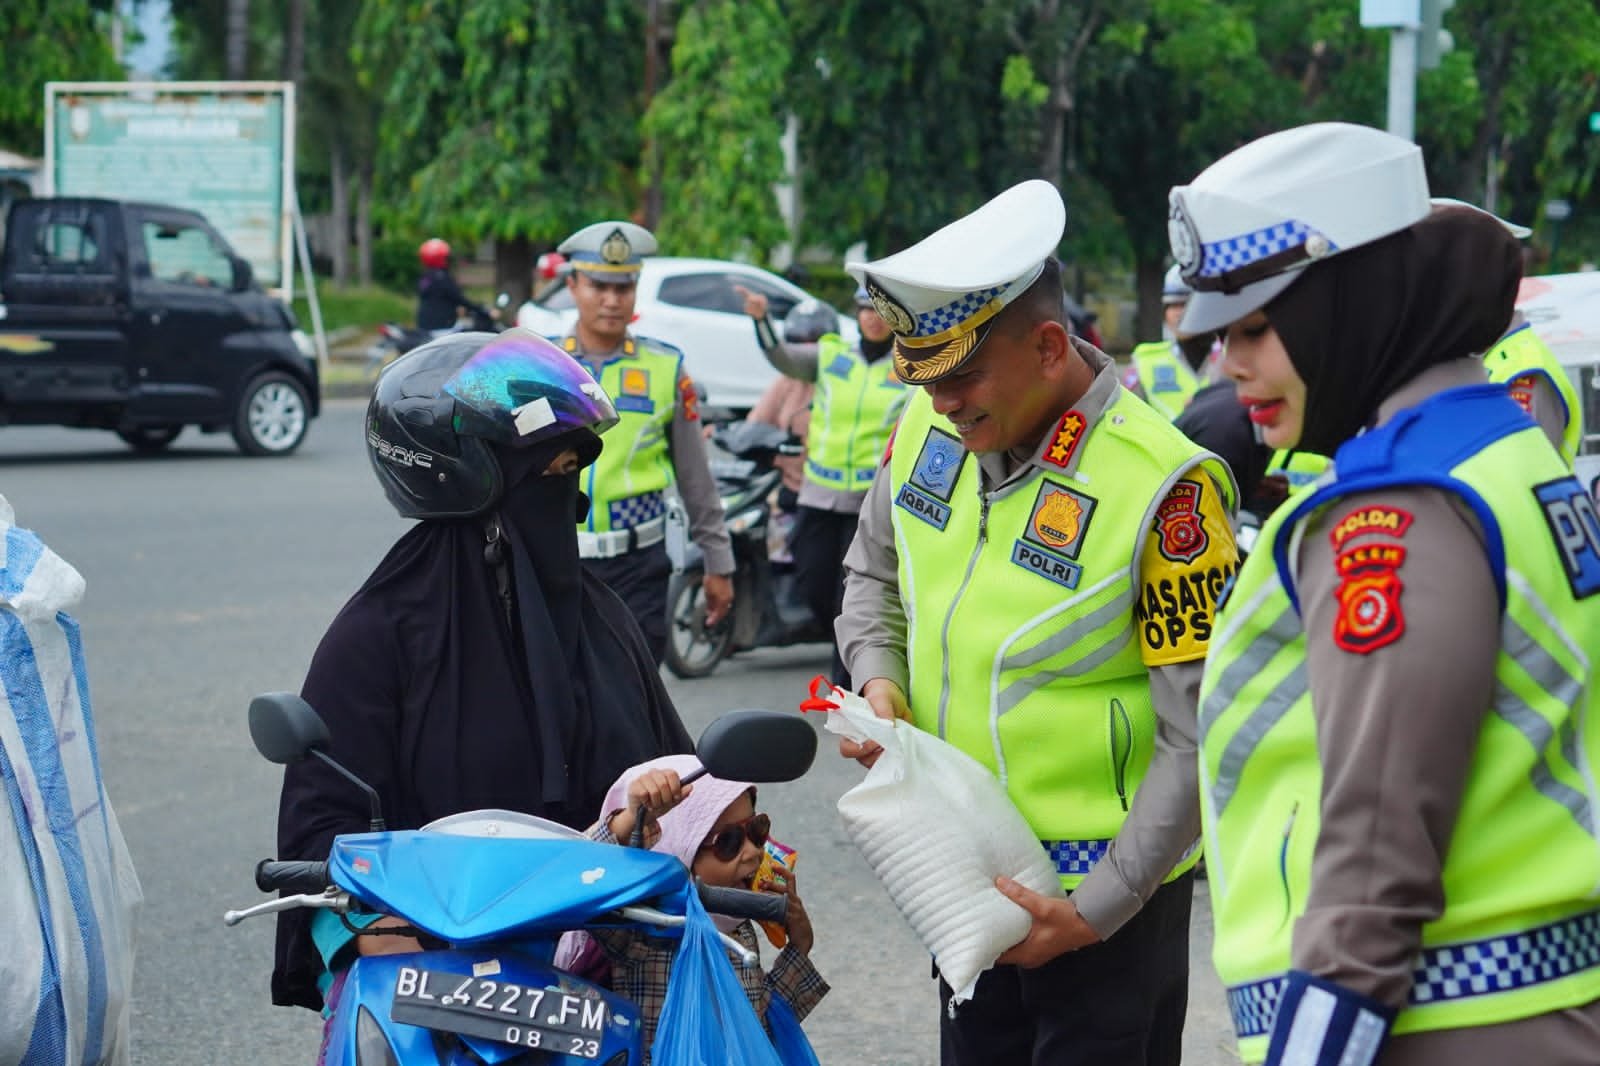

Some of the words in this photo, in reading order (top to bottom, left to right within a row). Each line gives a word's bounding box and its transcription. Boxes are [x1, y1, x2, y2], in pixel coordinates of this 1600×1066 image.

[901, 489, 942, 523] IQBAL
[1335, 509, 1399, 542] POLDA
[1019, 547, 1071, 581] POLRI
[1145, 611, 1211, 649] OPS
[396, 967, 435, 1001] BL
[452, 976, 545, 1019] 4227
[559, 995, 605, 1031] FM
[505, 1026, 542, 1048] 08
[569, 1037, 600, 1058] 23
